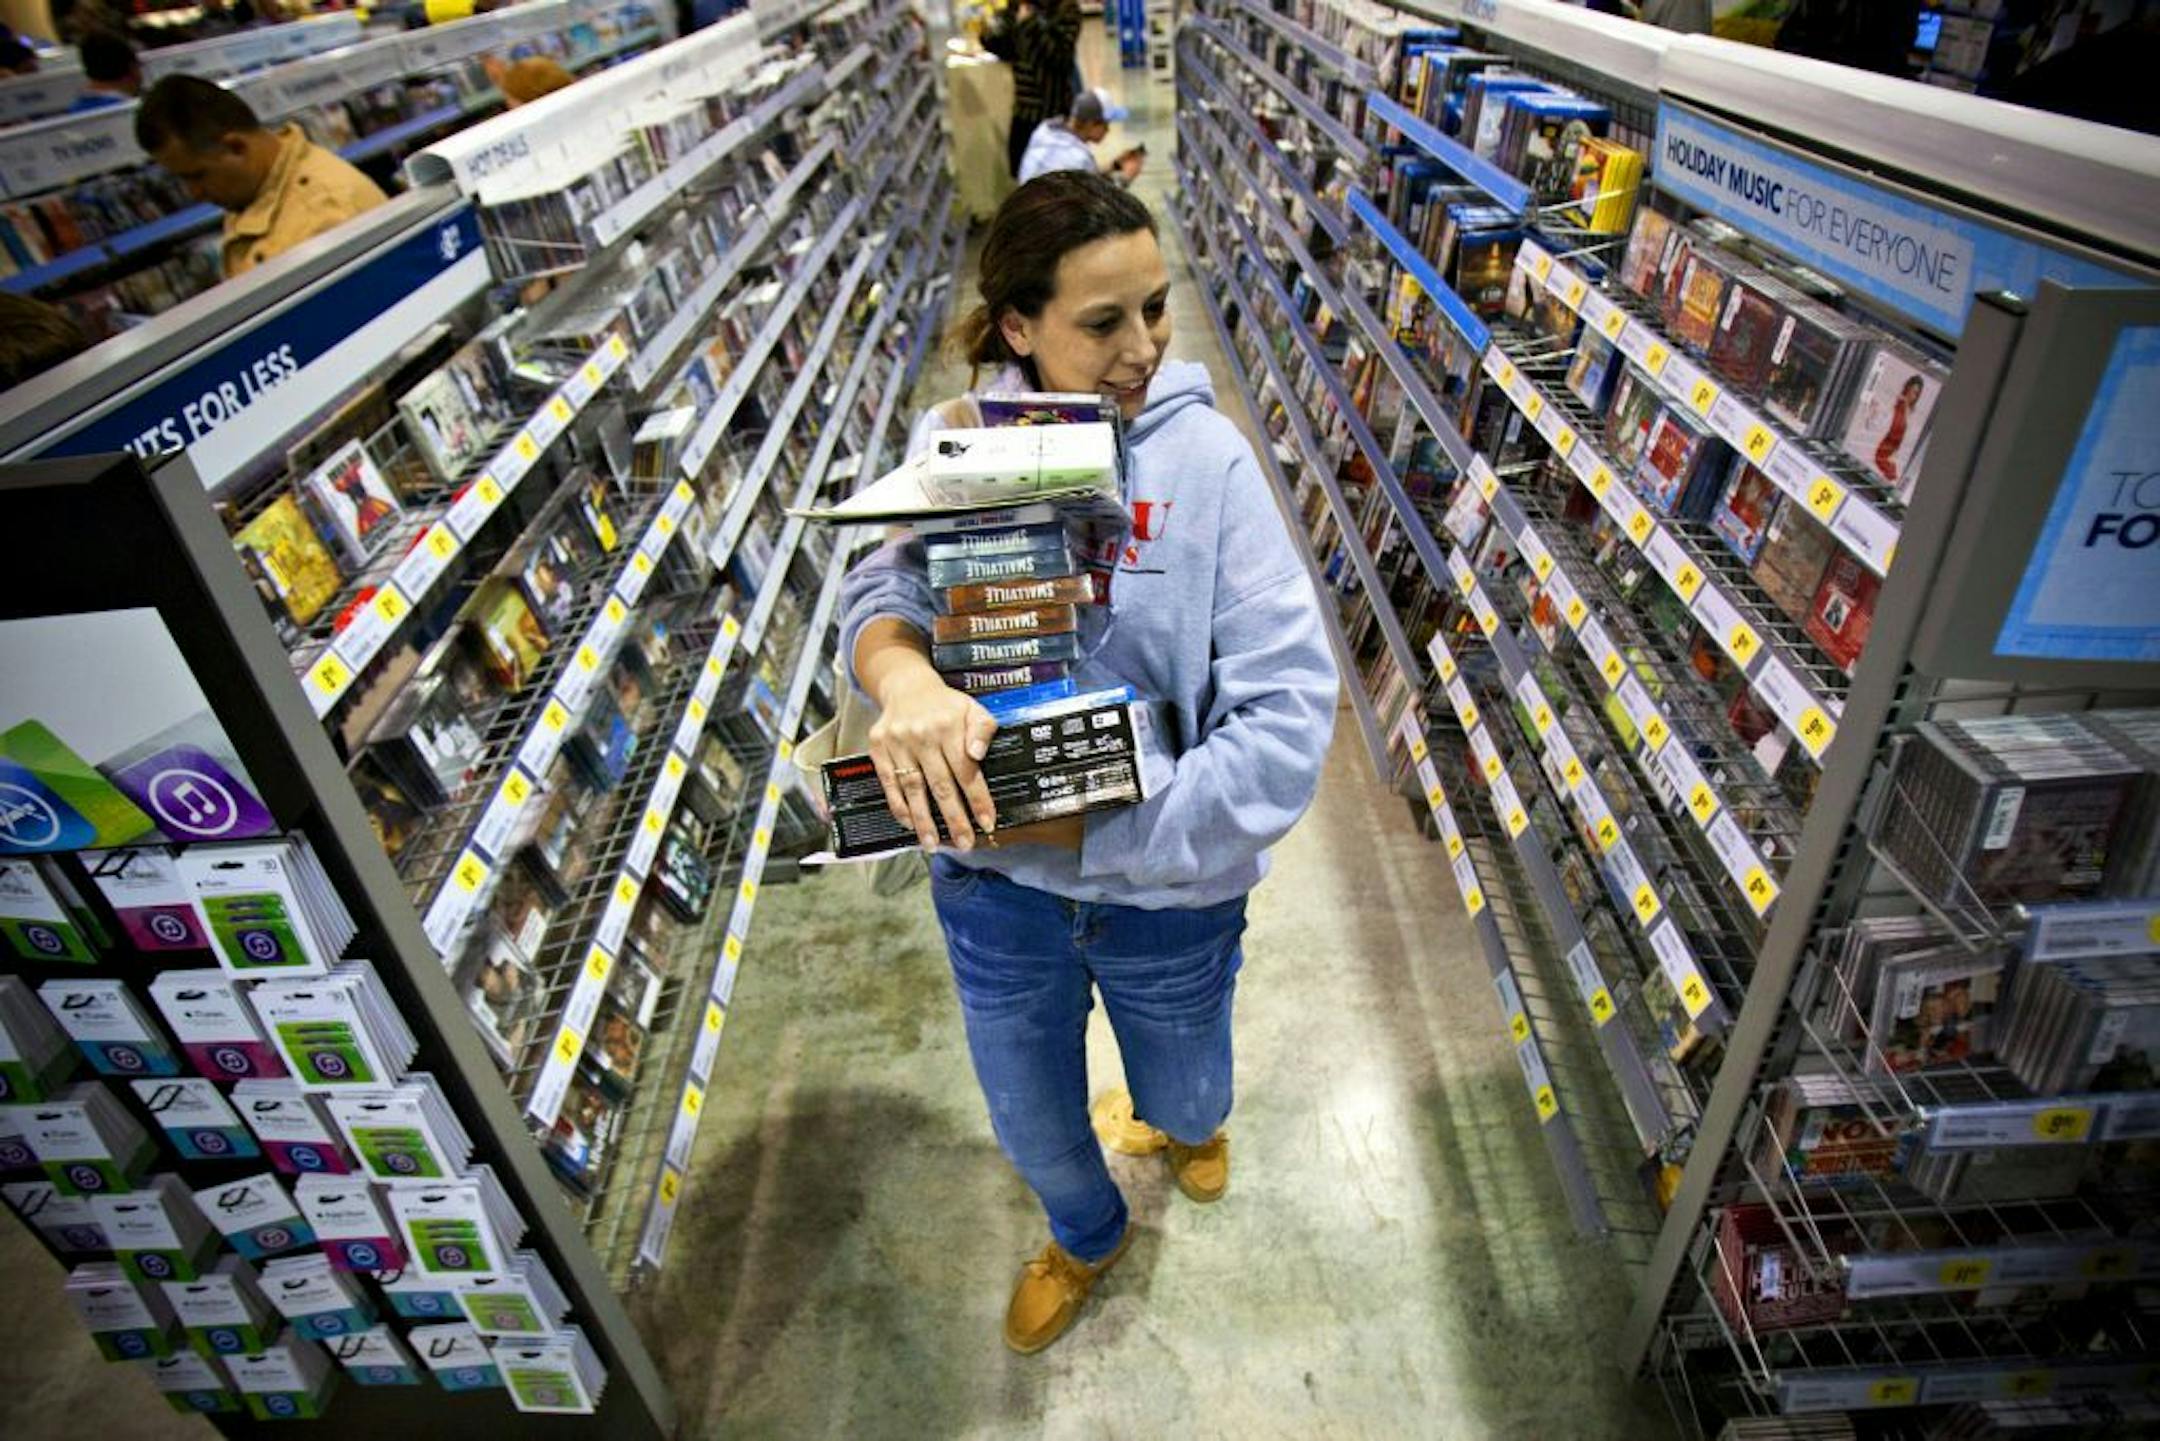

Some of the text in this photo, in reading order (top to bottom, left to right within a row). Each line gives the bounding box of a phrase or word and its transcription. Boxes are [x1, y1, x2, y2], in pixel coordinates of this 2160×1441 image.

[1666, 135, 1959, 293] HOLIDAY MUSIC FOR EVERYONE
[182, 381, 244, 441] FOR
[239, 343, 299, 406] LESS
[965, 556, 1035, 578] SMALLVILLE
[984, 581, 1055, 603] SMALLVILLE
[968, 610, 1040, 633] SMALLVILLE
[971, 638, 1040, 661] SMALLVILLE
[963, 665, 1033, 689] SMALLVILLE
